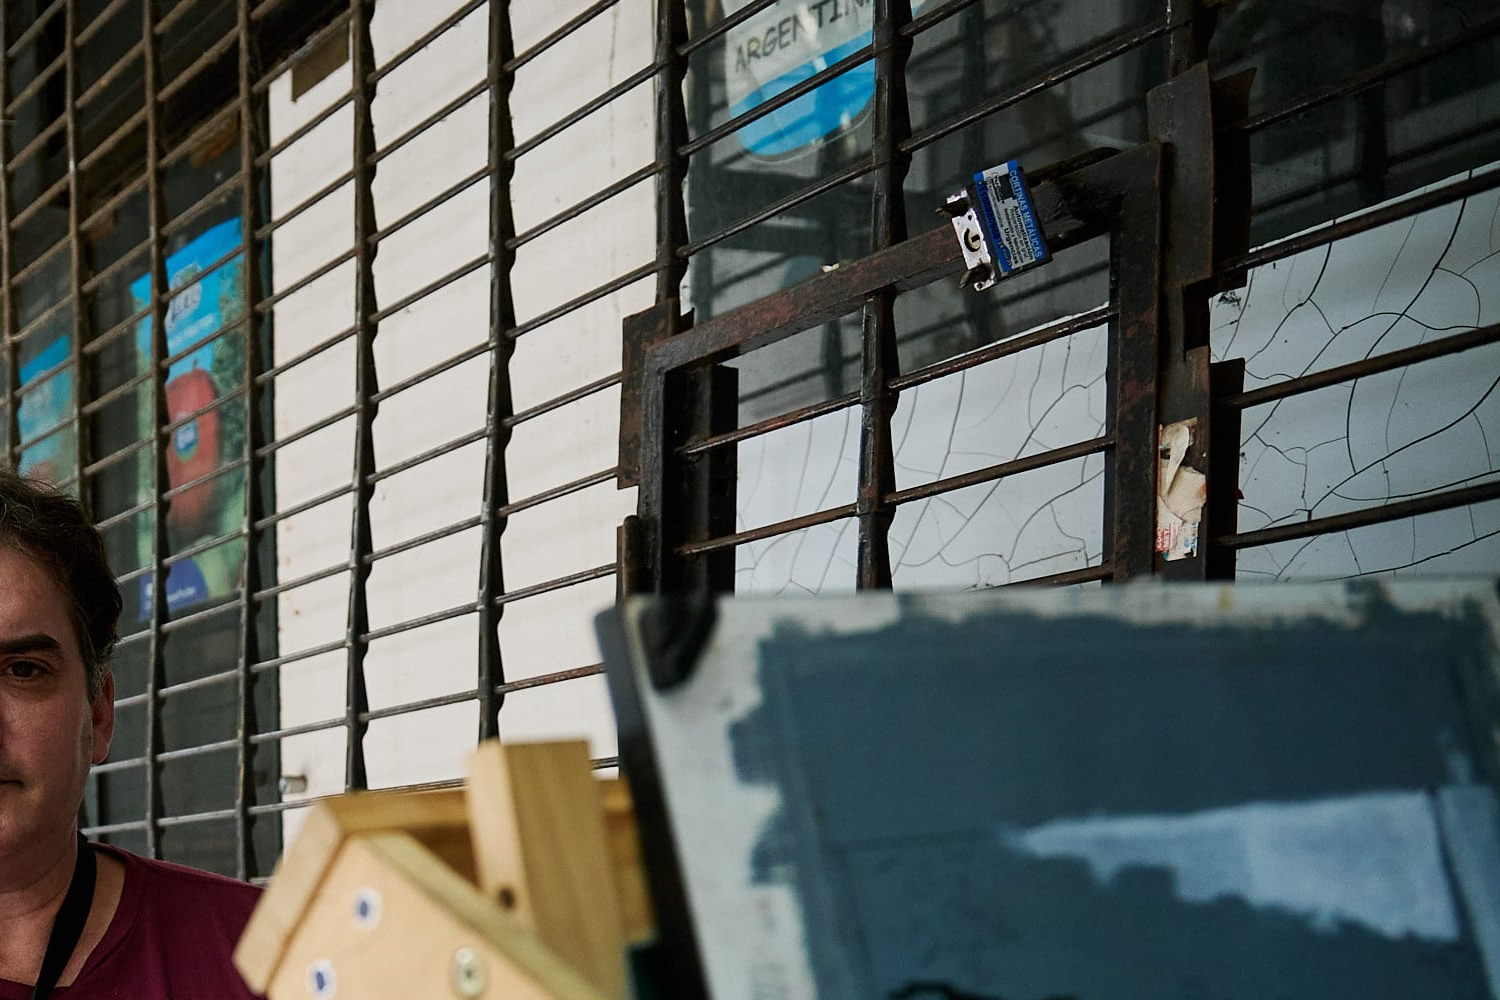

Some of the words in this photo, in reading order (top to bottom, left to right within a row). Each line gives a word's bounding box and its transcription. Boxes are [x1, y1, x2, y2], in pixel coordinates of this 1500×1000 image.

[736, 0, 871, 72] ARGENTIN
[1004, 228, 1019, 264] Urgencias
[1010, 170, 1028, 211] CORTINAS
[1023, 211, 1043, 258] METÁLICAS
